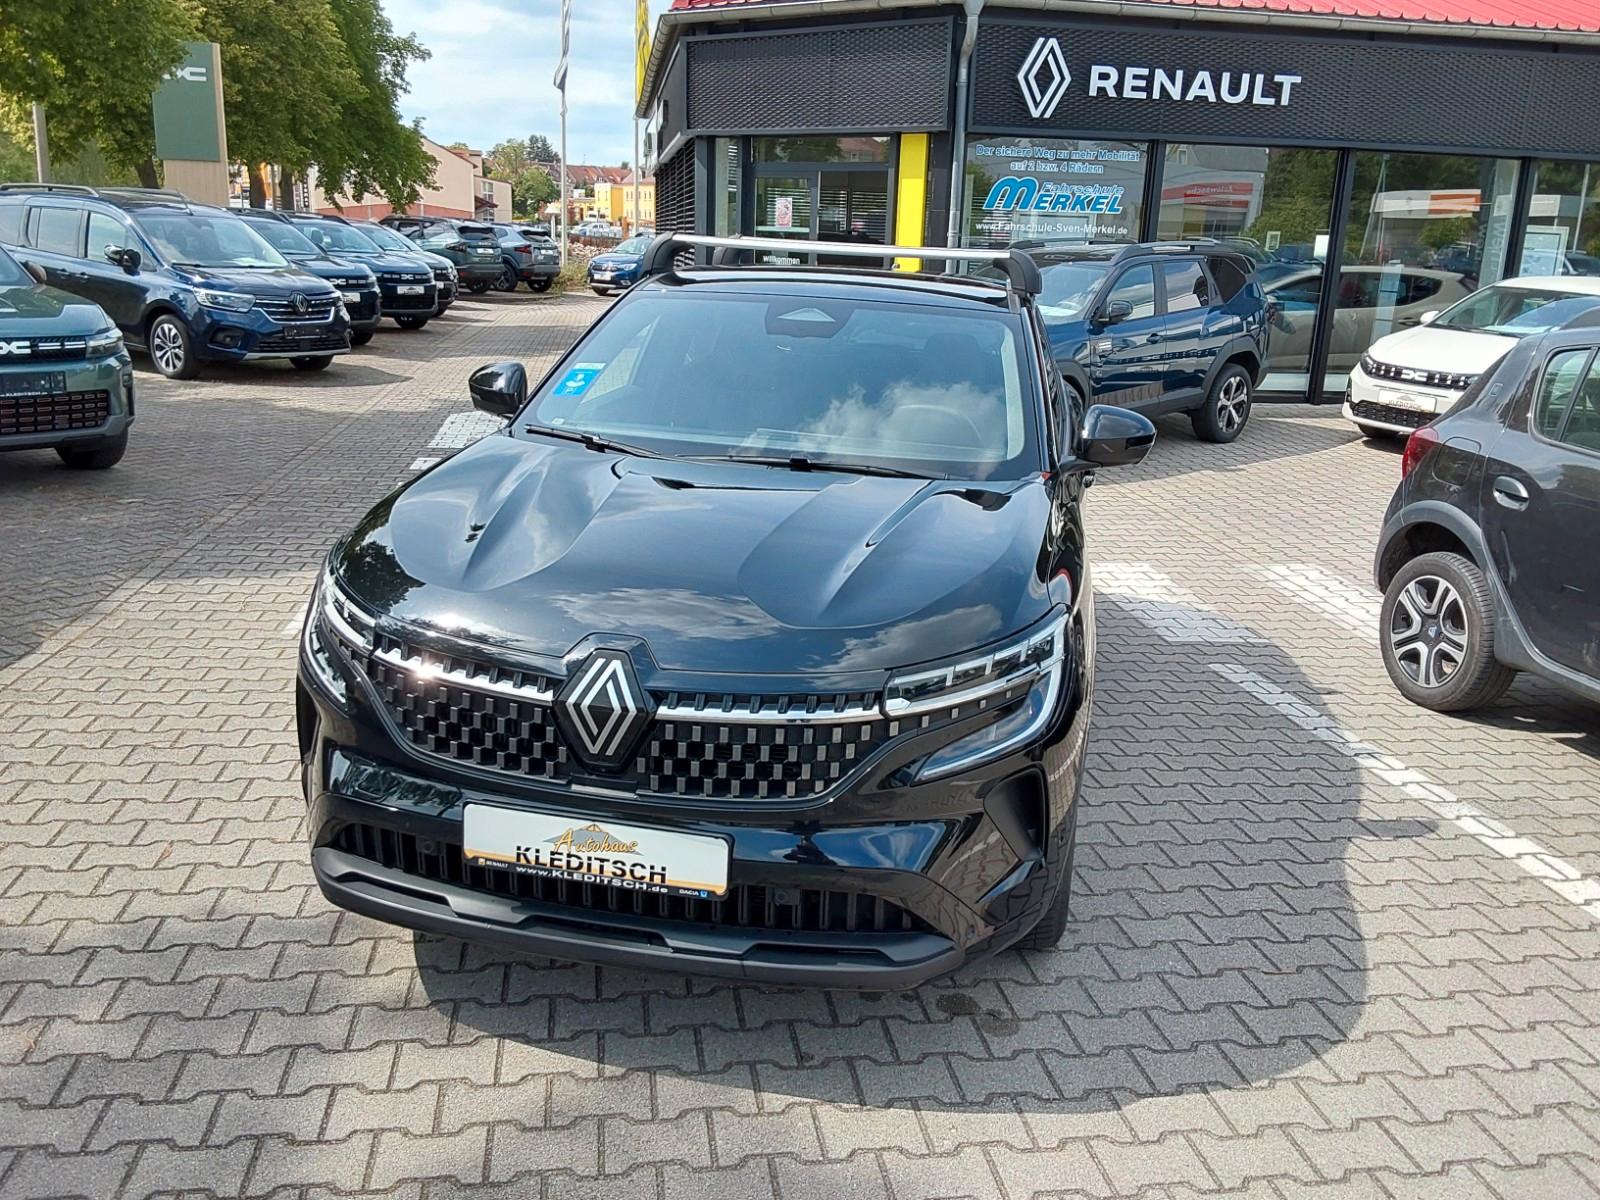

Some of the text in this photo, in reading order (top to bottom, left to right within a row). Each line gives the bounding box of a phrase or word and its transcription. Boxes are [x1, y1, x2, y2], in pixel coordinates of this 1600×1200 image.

[1088, 64, 1302, 106] RENAULT
[976, 144, 1140, 161] Der sichere Weg zu mehr Mobilität
[1010, 160, 1104, 174] auf 2 bzw. 4 Rädern
[982, 176, 1123, 214] MERKEL
[1041, 182, 1125, 195] Fahrschule
[553, 828, 638, 854] Autohaus
[516, 845, 667, 884] KLEDITSCH
[515, 866, 669, 894] www.KLEDITSCH.de
[679, 888, 699, 897] DACIA
